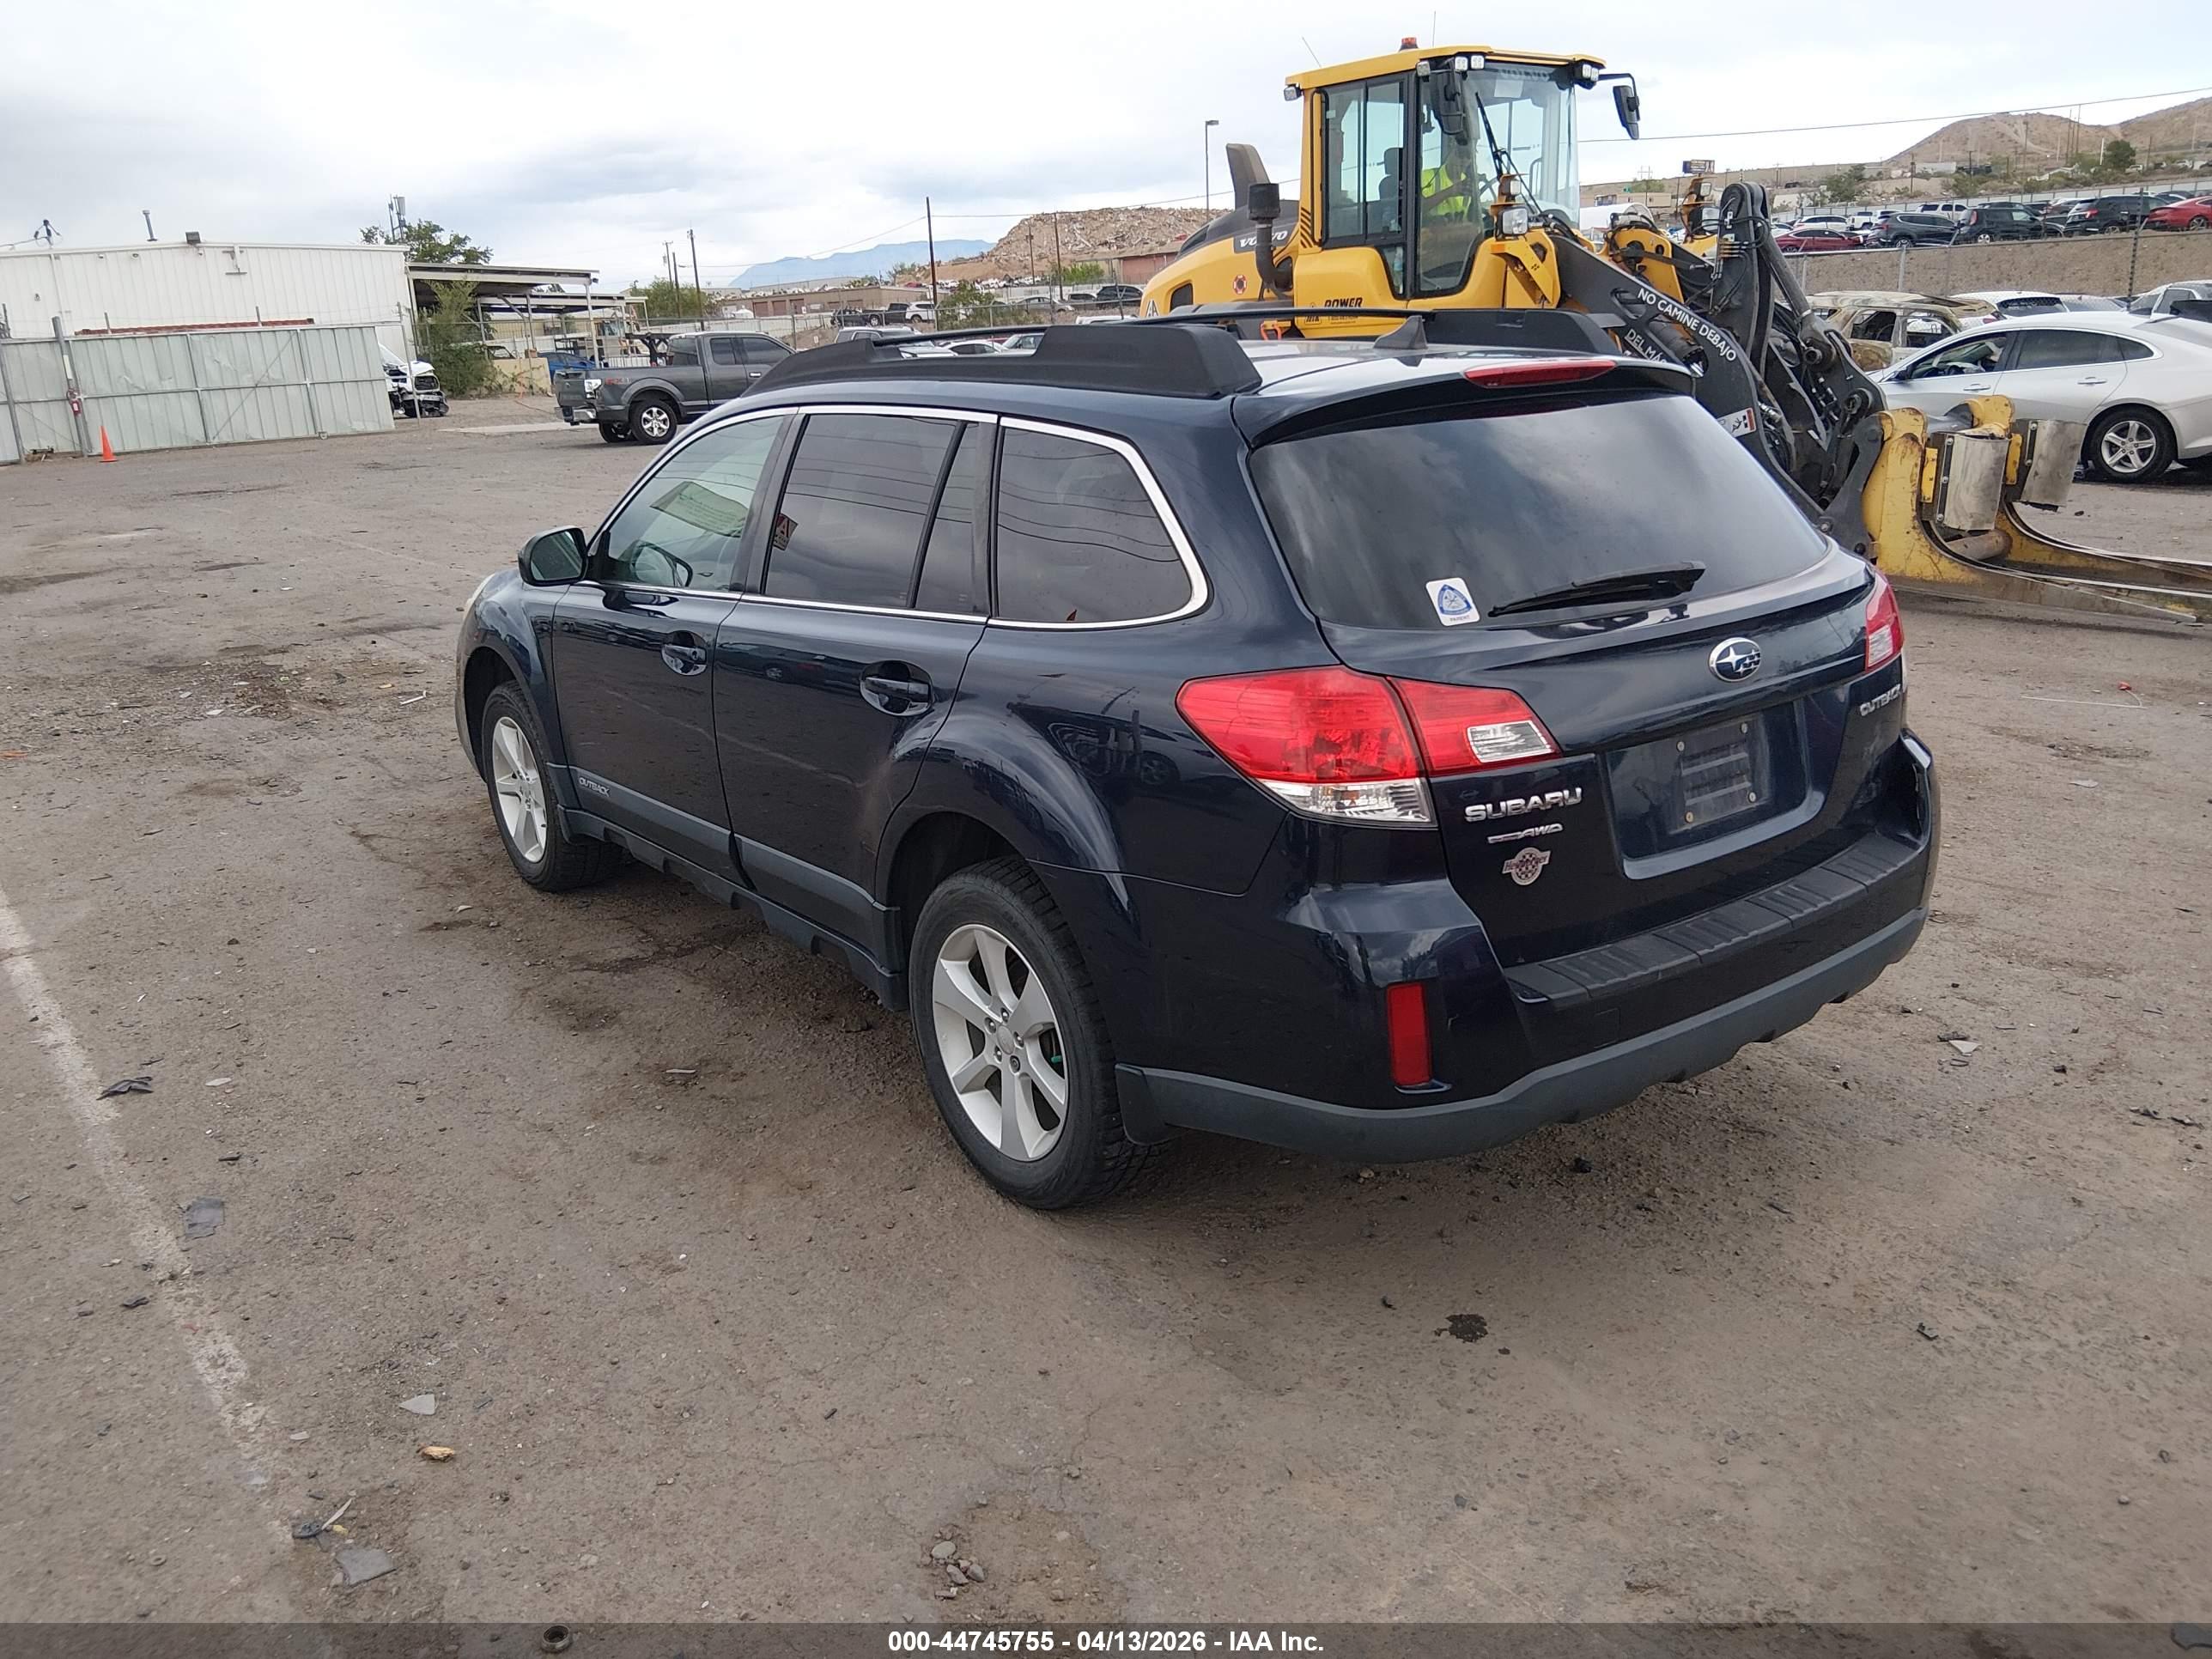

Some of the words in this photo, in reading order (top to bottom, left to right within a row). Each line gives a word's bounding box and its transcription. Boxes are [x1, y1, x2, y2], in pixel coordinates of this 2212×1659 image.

[1240, 230, 1288, 248] VOVO
[1324, 297, 1363, 308] POWER
[1638, 288, 1656, 305] NO
[1657, 300, 1700, 331] CAMINE
[1698, 324, 1736, 362] DEBAJO
[1626, 328, 1645, 351] DEL
[1860, 684, 1901, 716] OUTBACK
[579, 777, 610, 797] OUTBACK
[1465, 787, 1583, 822] SUBARU
[1520, 823, 1564, 838] AWD
